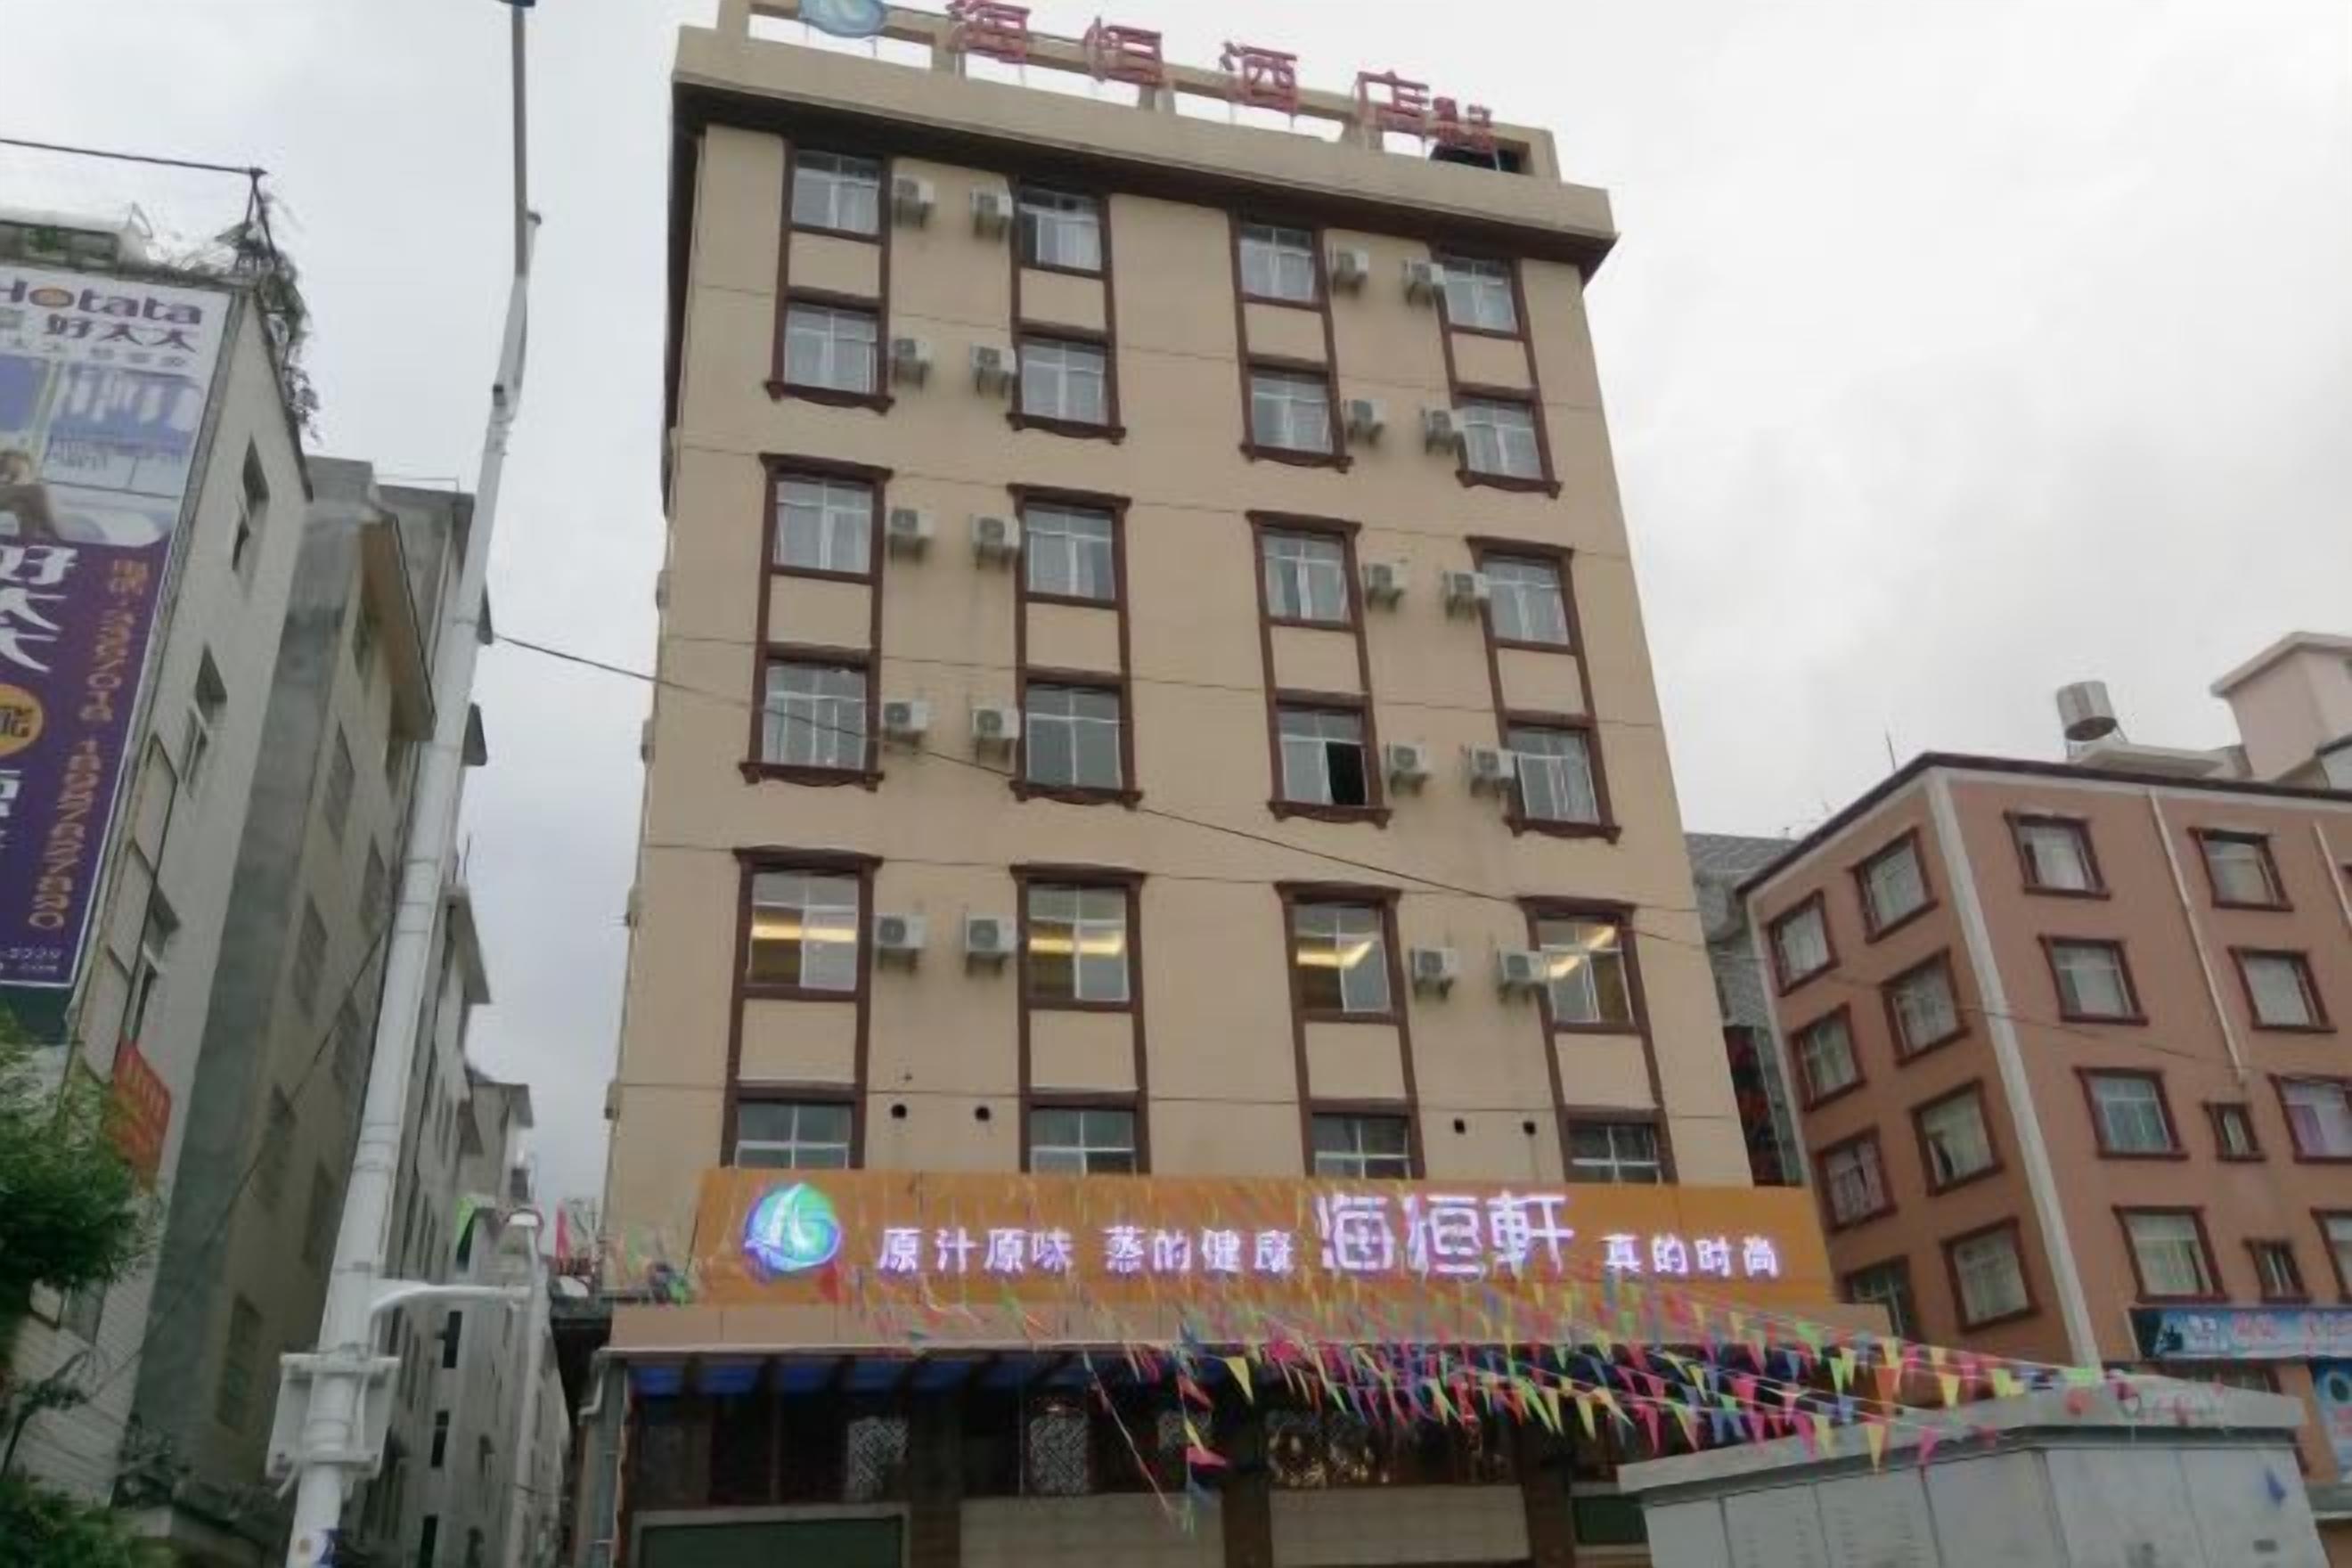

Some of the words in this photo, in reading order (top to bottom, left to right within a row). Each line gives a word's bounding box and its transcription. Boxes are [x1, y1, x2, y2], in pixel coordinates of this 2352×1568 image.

[878, 1227, 1073, 1273] 原汁原味
[1103, 1225, 1294, 1273] 蒸的健康
